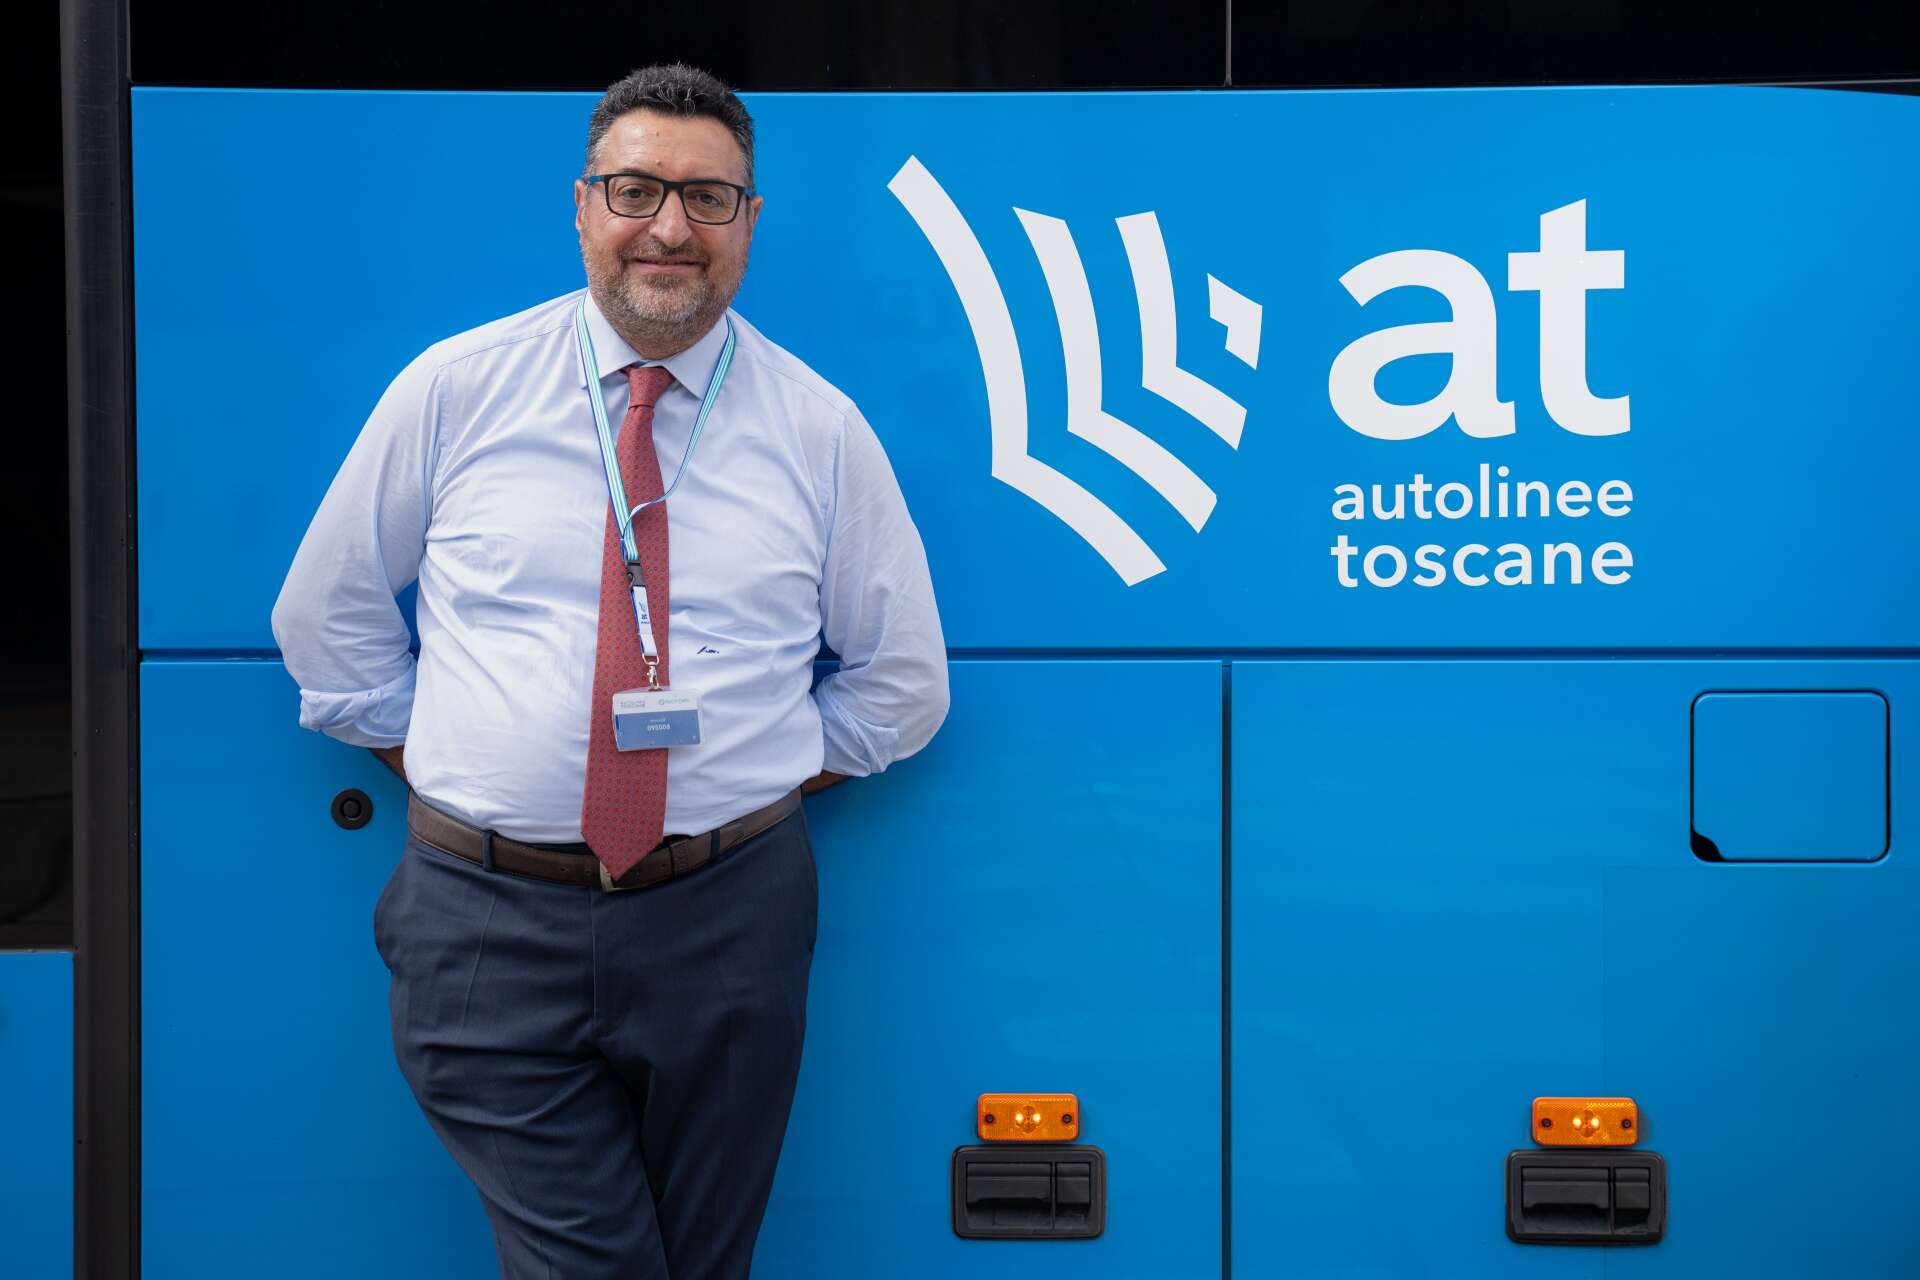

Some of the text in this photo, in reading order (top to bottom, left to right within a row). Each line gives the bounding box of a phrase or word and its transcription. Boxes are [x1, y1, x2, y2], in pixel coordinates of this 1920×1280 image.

[1328, 198, 1631, 441] at
[1331, 463, 1634, 521] autolinee
[1330, 534, 1634, 588] toscane
